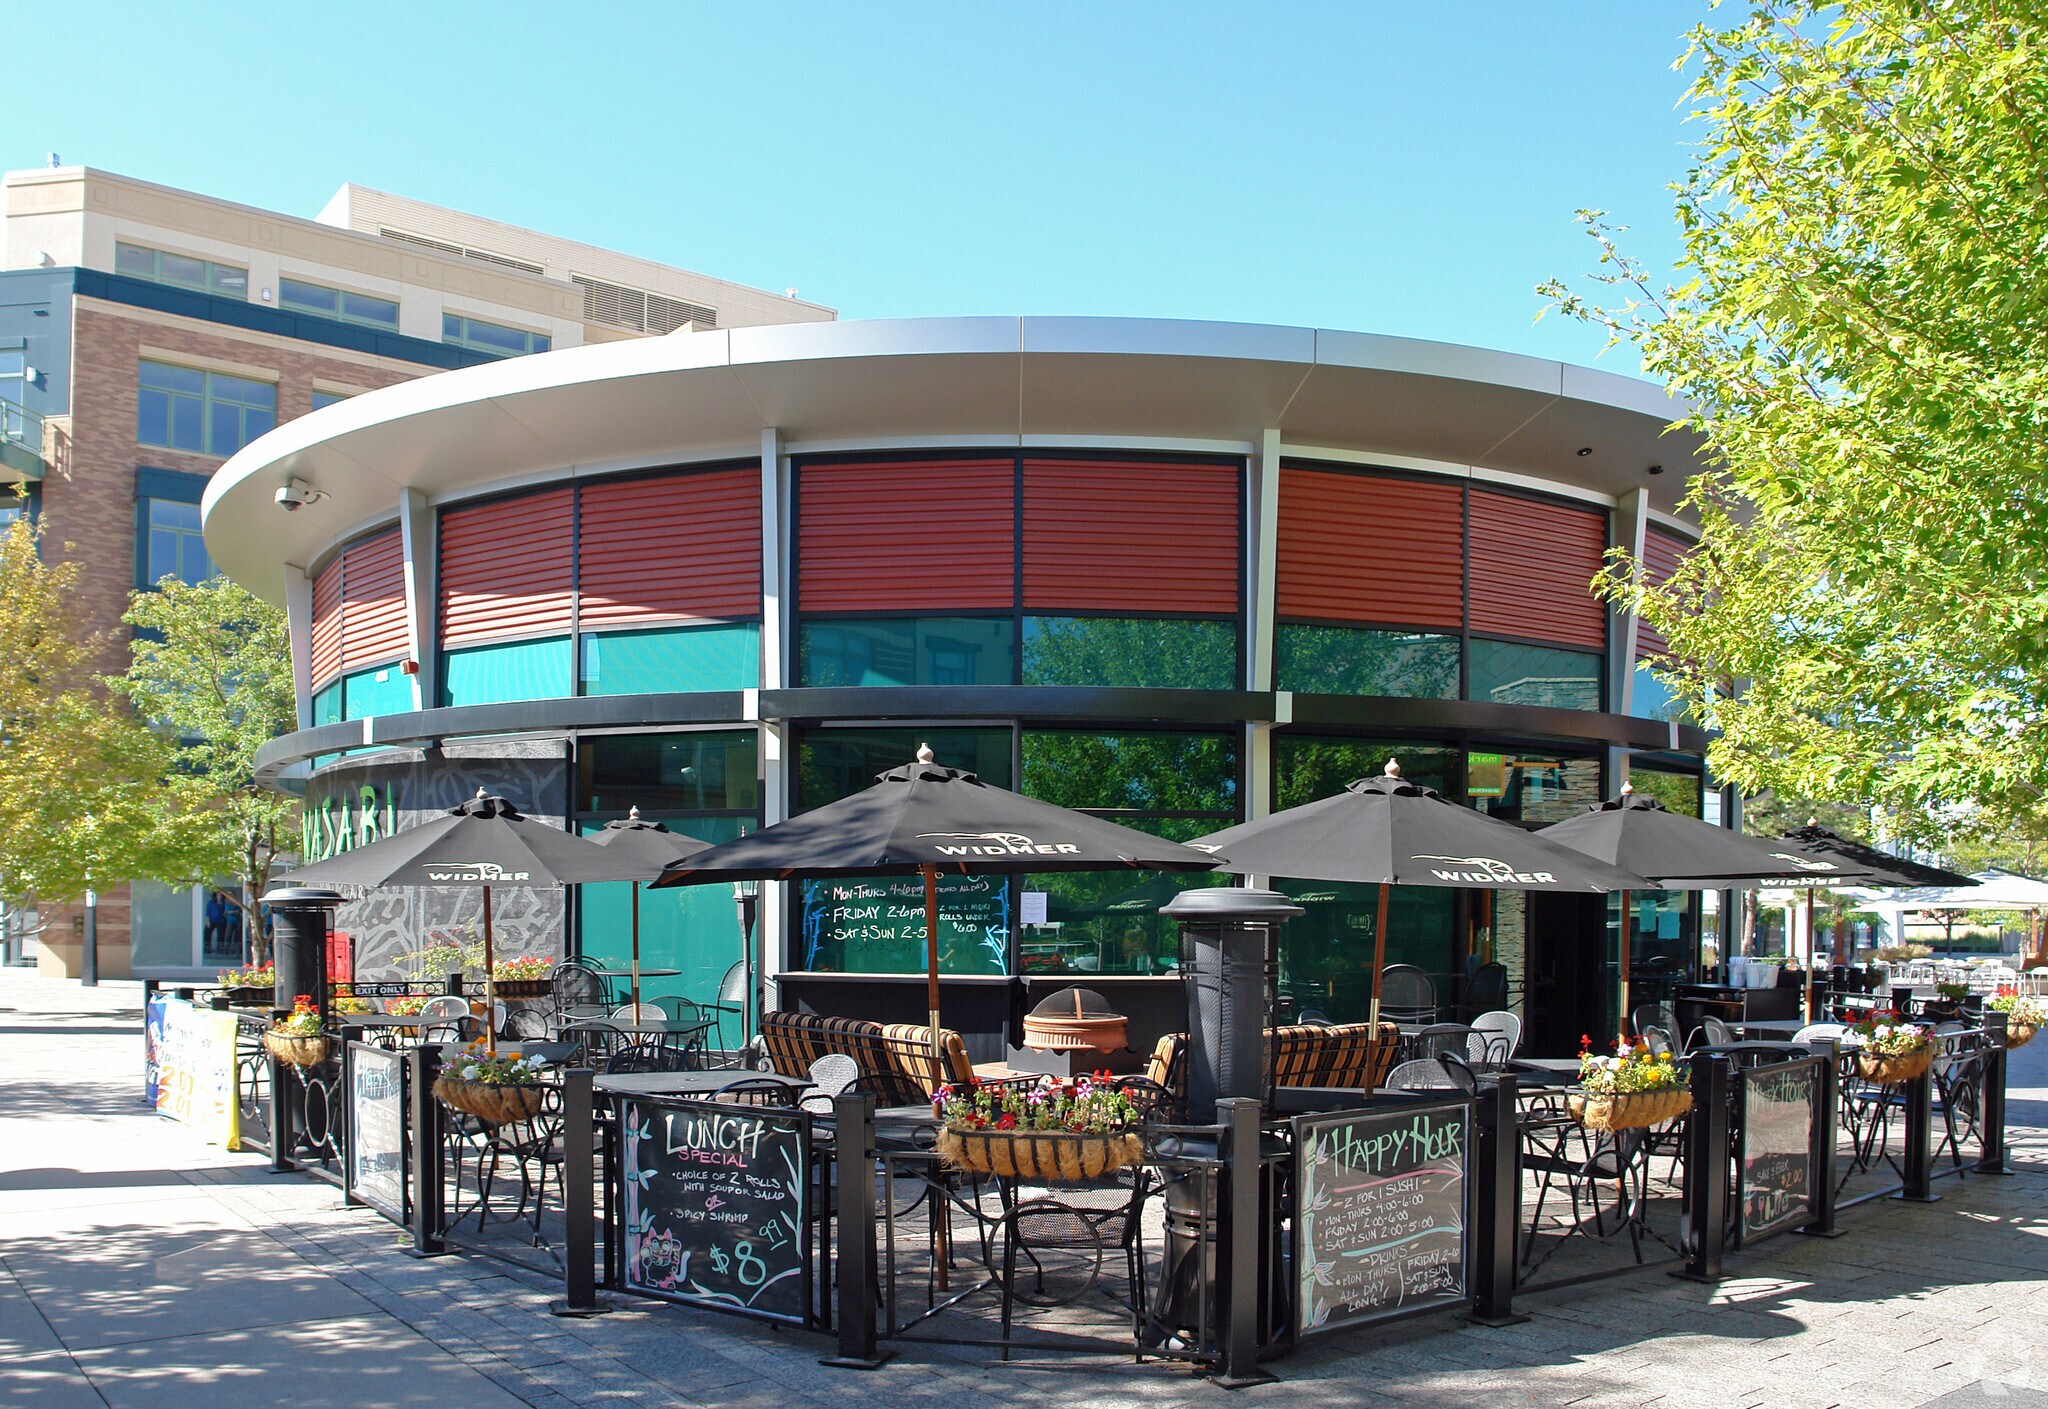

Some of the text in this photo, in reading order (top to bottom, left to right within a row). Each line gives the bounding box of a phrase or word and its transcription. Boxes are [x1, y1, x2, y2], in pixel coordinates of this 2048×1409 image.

[934, 843, 1082, 856] WIDMER
[428, 872, 530, 881] WIDMER
[1431, 869, 1558, 884] WIDMER
[1760, 877, 1841, 886] WIDMER
[833, 905, 926, 923] FRIDAY 2-6pm
[939, 913, 991, 921] ROLLS UNDER
[834, 928, 859, 940] SAT
[869, 925, 895, 939] SUN
[355, 986, 405, 995] EXIT ONLY
[665, 1114, 766, 1159] LUNCH
[1330, 1115, 1461, 1177] HAPPY HOUR
[678, 1149, 748, 1168] SPECIAL
[676, 1171, 781, 1189] CHOICE OF 2 ROLLS
[684, 1183, 785, 1200] WITH SOUP OR SALAD
[1344, 1197, 1352, 1209] 2
[1356, 1190, 1377, 1205] FOR
[1385, 1177, 1419, 1196] SUSHI
[705, 1194, 723, 1208] OR
[1324, 1193, 1424, 1226] MON-THURS 4:00-6:00
[676, 1209, 749, 1224] SPICY SHRIMP
[1325, 1211, 1409, 1239] FRIDAY 2:00-6:00
[1325, 1238, 1347, 1251] SAT
[1357, 1228, 1377, 1244] SUN
[1380, 1216, 1434, 1238] 2:00-5:00
[1369, 1246, 1408, 1266] DRINKS
[1407, 1251, 1440, 1270] FRIDAY
[1343, 1265, 1398, 1287] MON-THURS
[1405, 1272, 1422, 1285] SAT
[1429, 1262, 1451, 1277] SUN
[1339, 1279, 1385, 1303] ALL DAY
